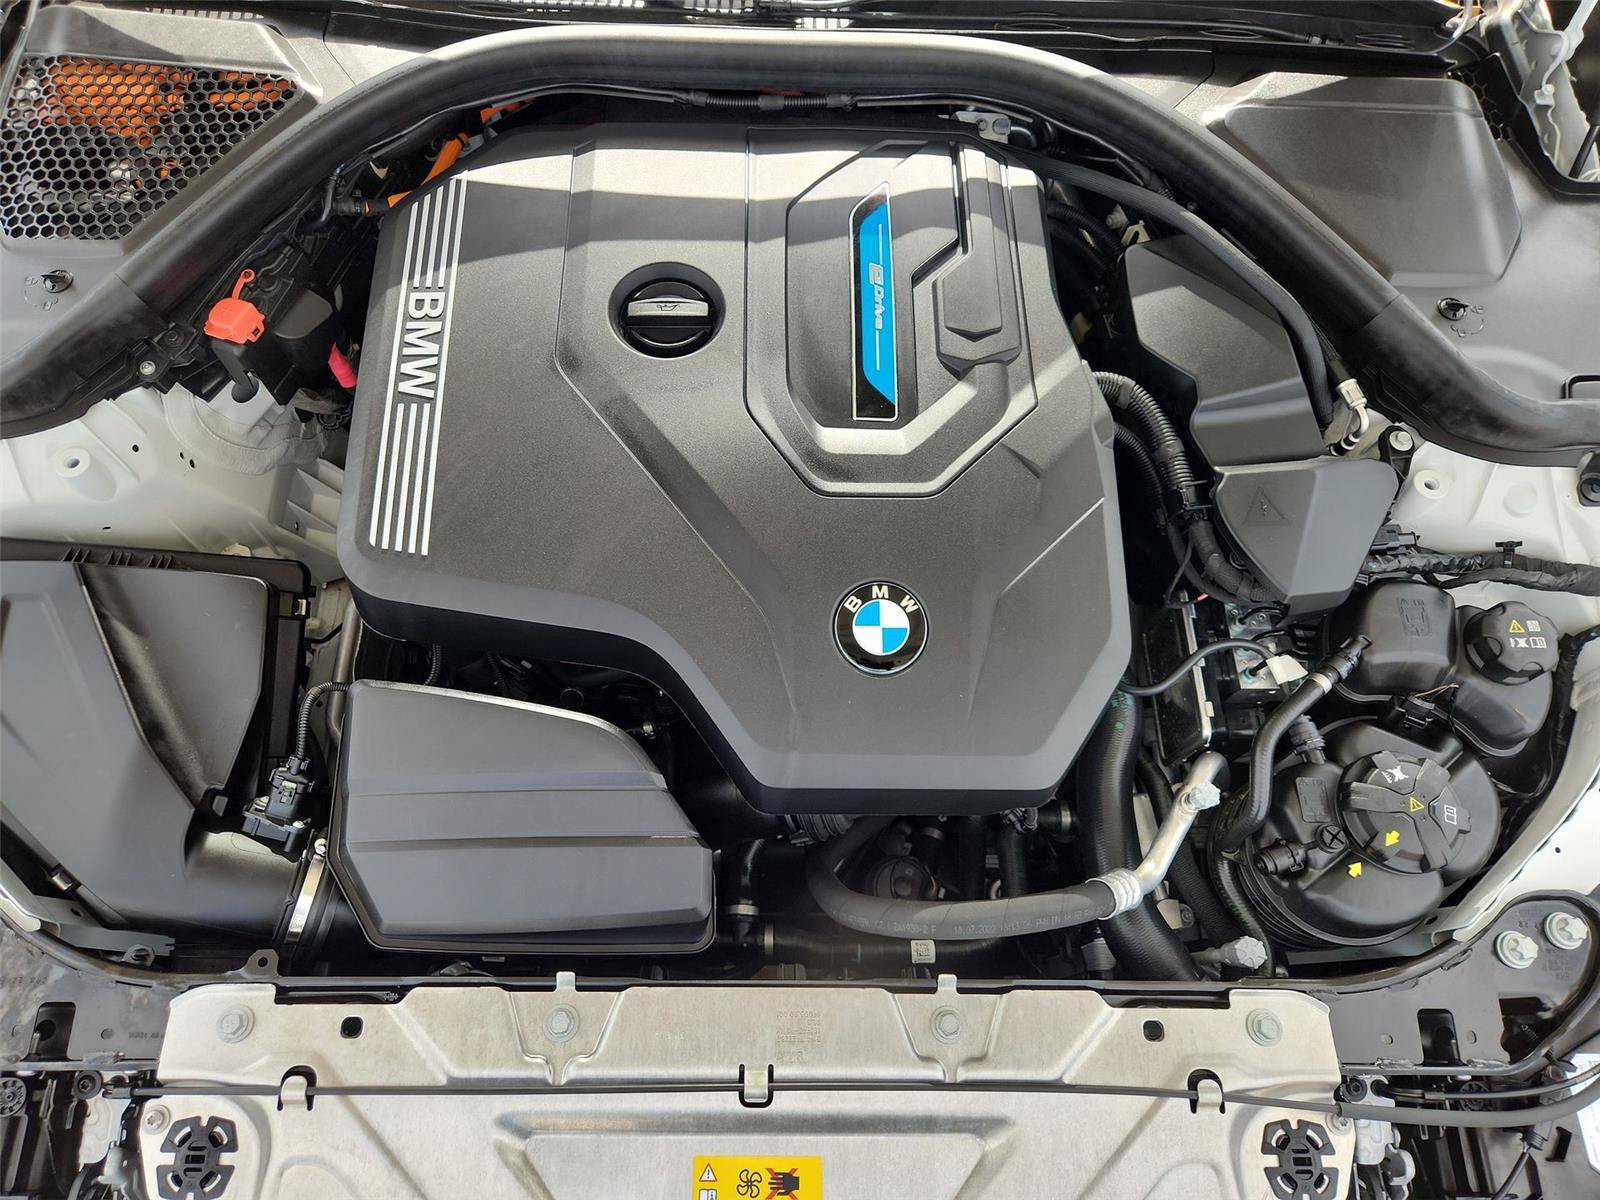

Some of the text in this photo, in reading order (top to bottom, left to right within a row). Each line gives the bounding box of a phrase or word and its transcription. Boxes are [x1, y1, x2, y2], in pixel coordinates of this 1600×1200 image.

[869, 262, 885, 330] eDrive
[398, 292, 446, 399] BMW
[844, 585, 919, 613] BMW
